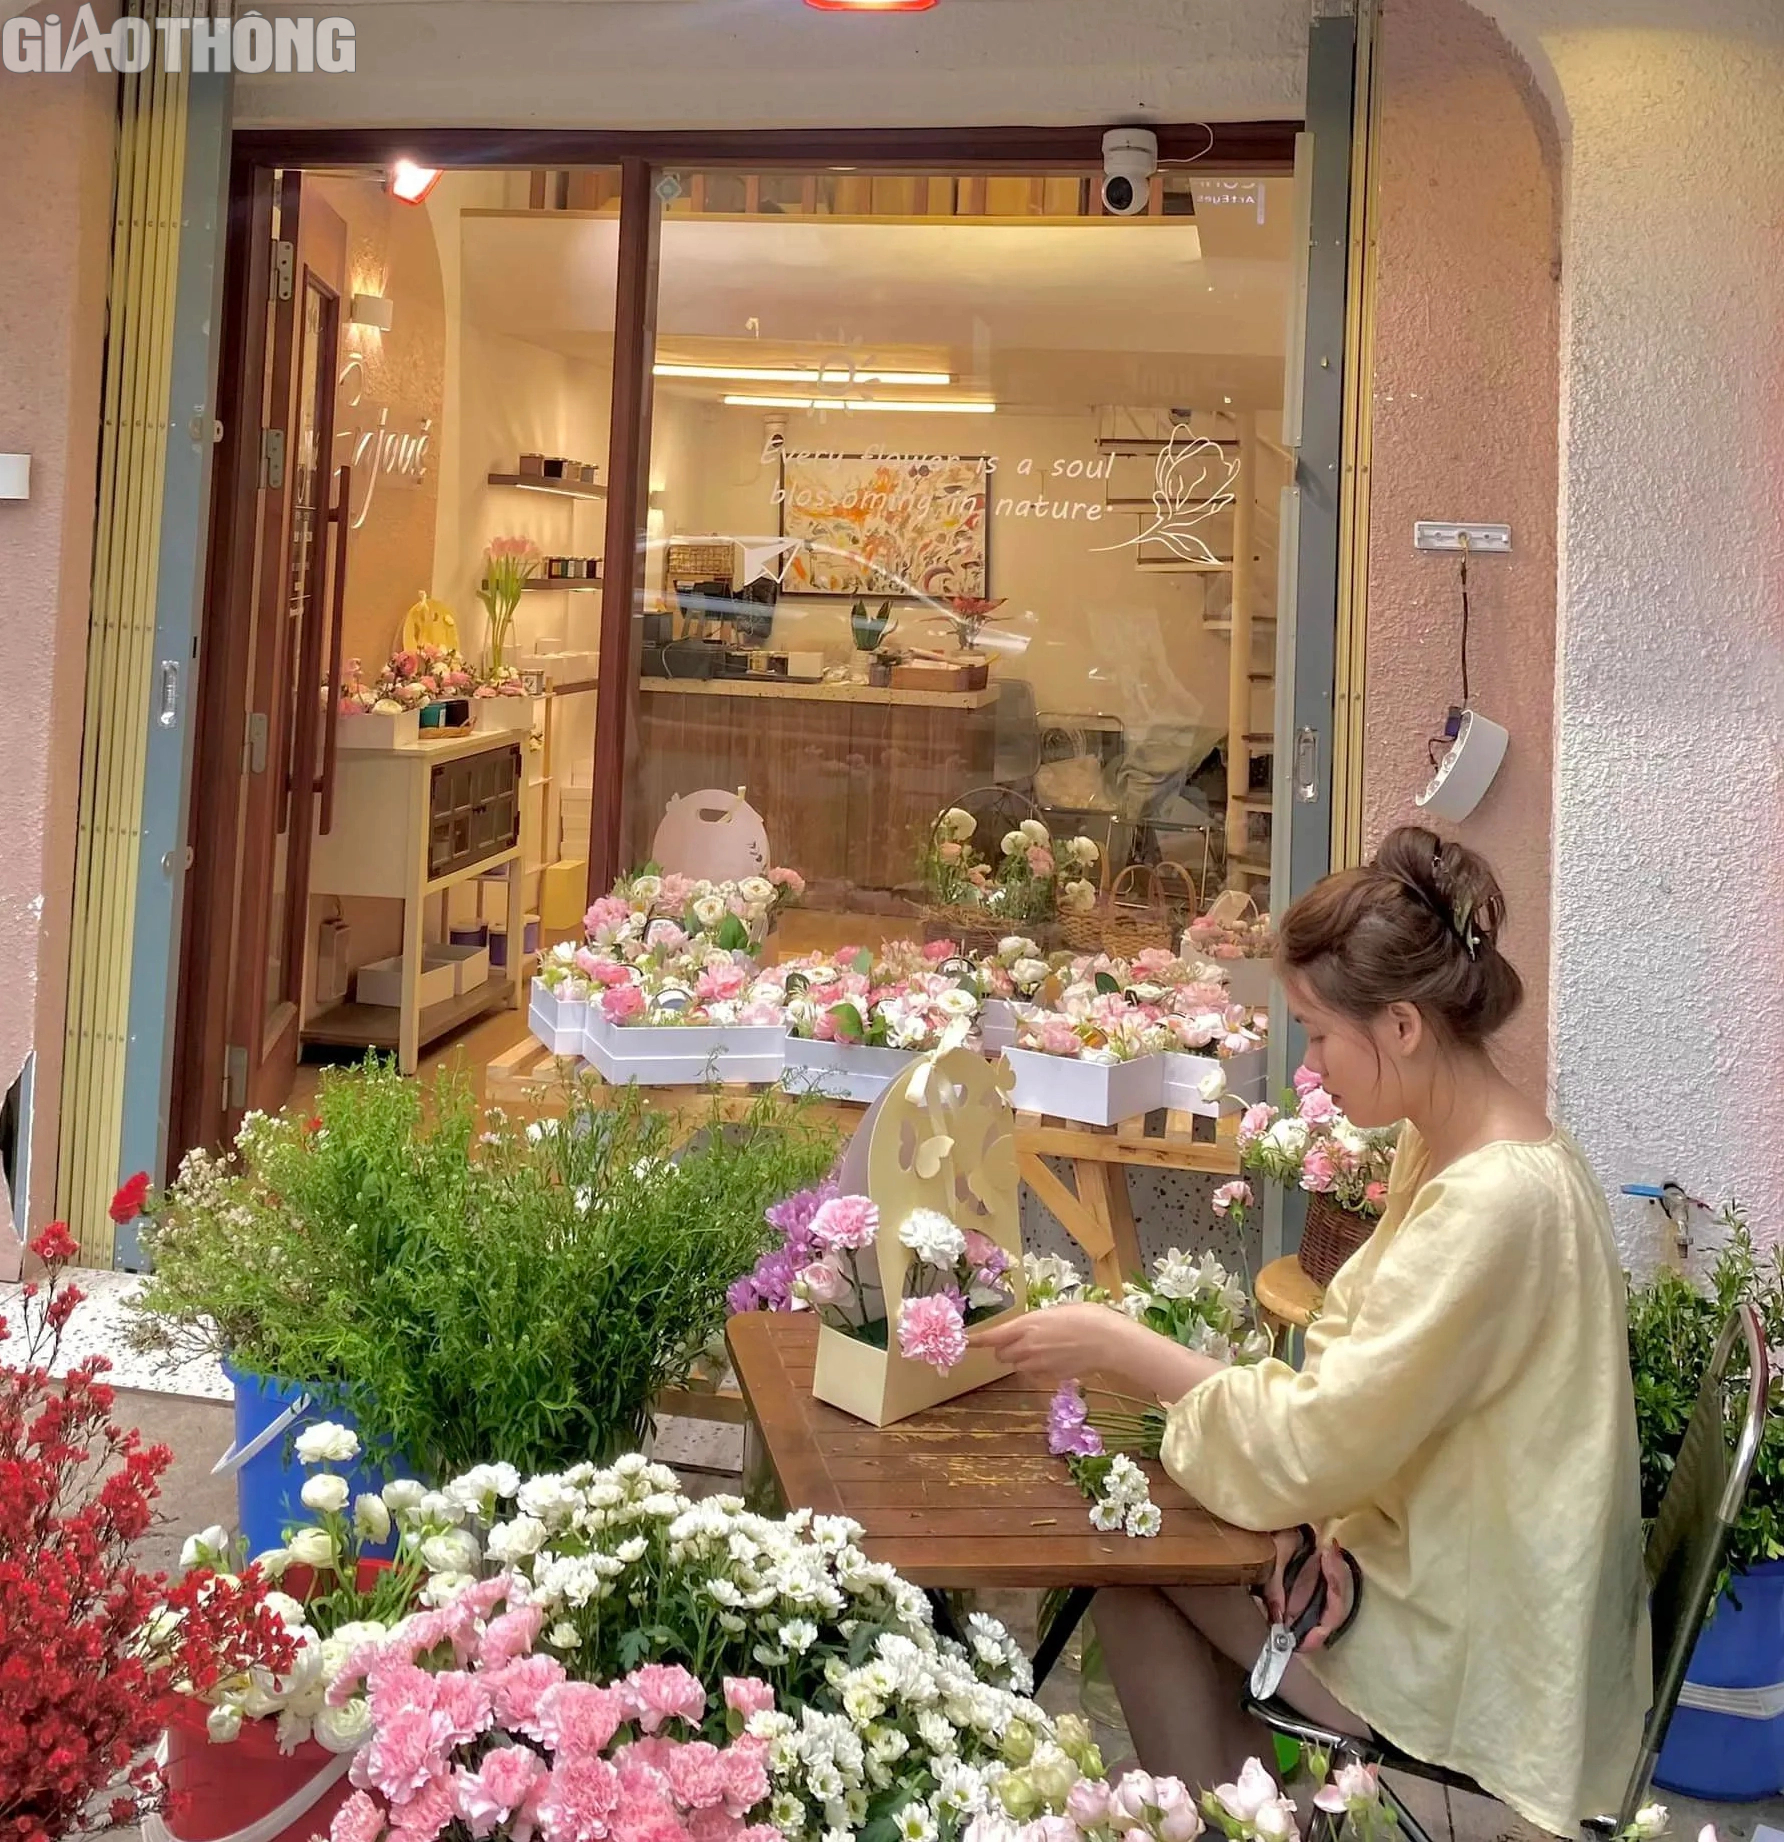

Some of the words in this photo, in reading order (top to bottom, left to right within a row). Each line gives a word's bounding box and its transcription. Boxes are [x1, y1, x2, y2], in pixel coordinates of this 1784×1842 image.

[761, 437, 844, 474] Every
[861, 444, 961, 470] flower
[976, 451, 998, 474] is
[1017, 458, 1033, 475] a
[1051, 452, 1116, 479] soul
[770, 478, 931, 517] blossoming
[950, 490, 977, 514] in
